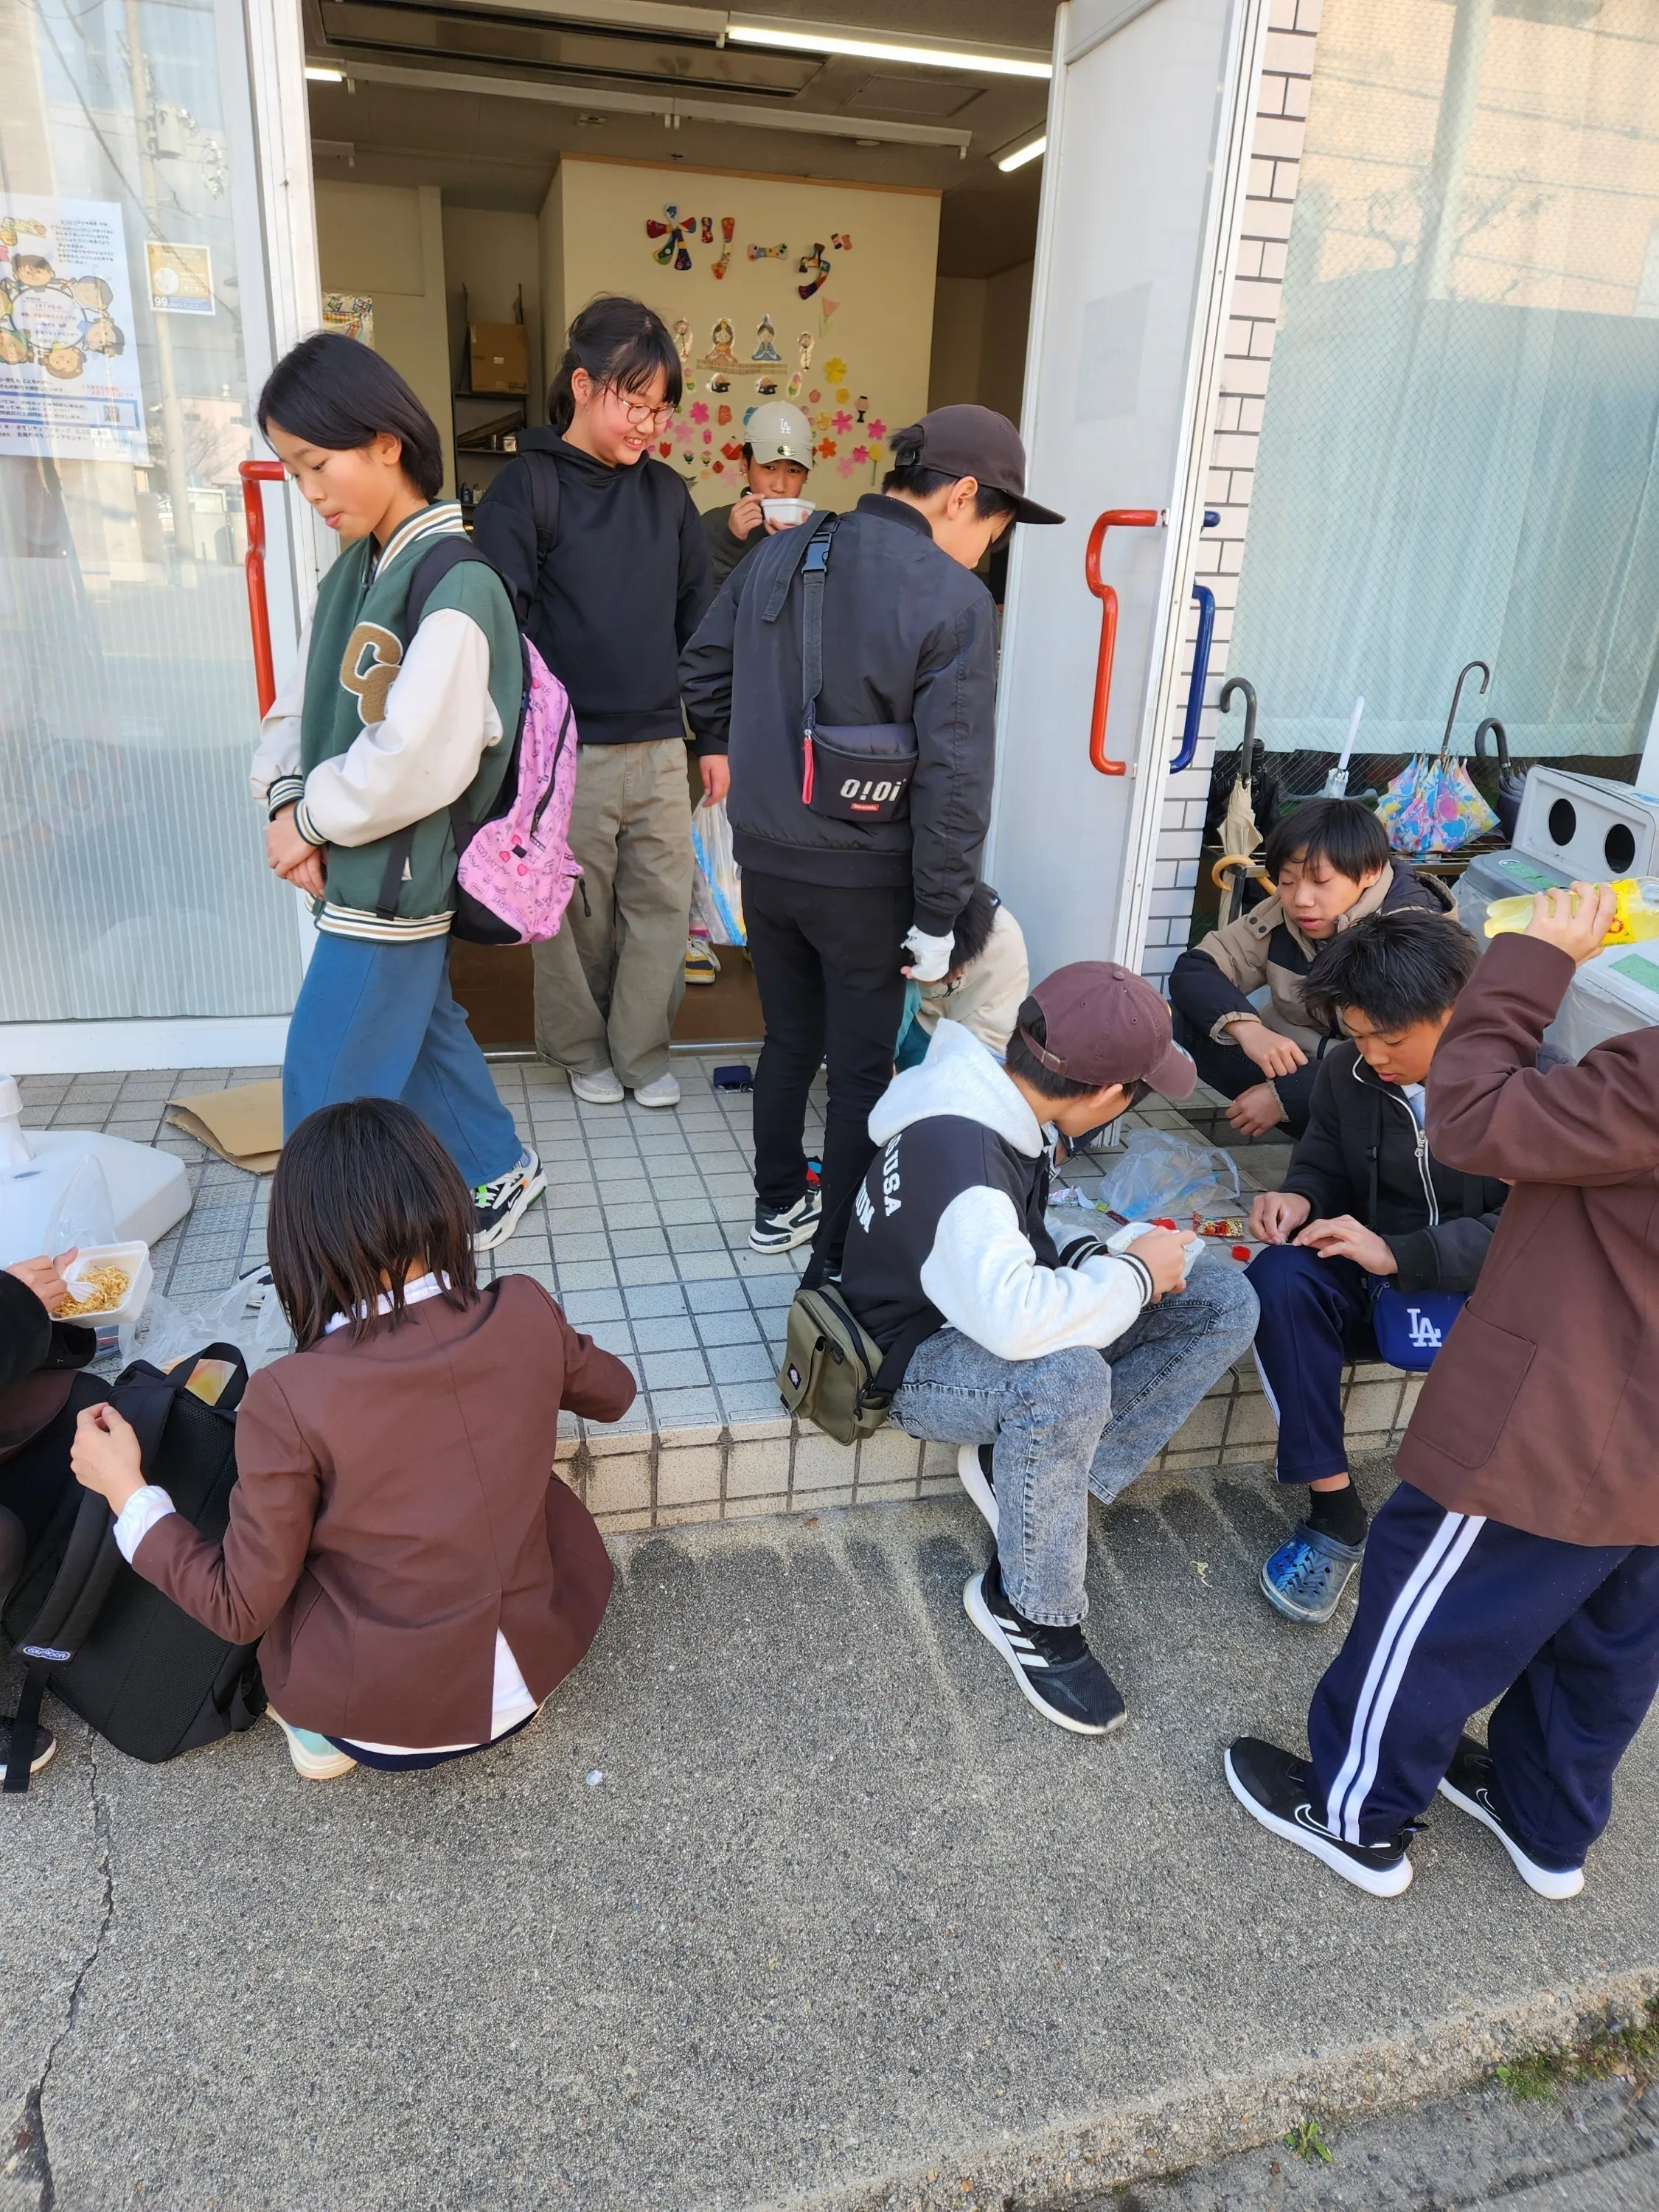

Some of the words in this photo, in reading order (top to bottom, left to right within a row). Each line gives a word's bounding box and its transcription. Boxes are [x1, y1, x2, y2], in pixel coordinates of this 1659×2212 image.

[779, 418, 791, 434] LA
[1406, 1308, 1443, 1348] LA
[27, 1647, 67, 1659] OUTDOOR
